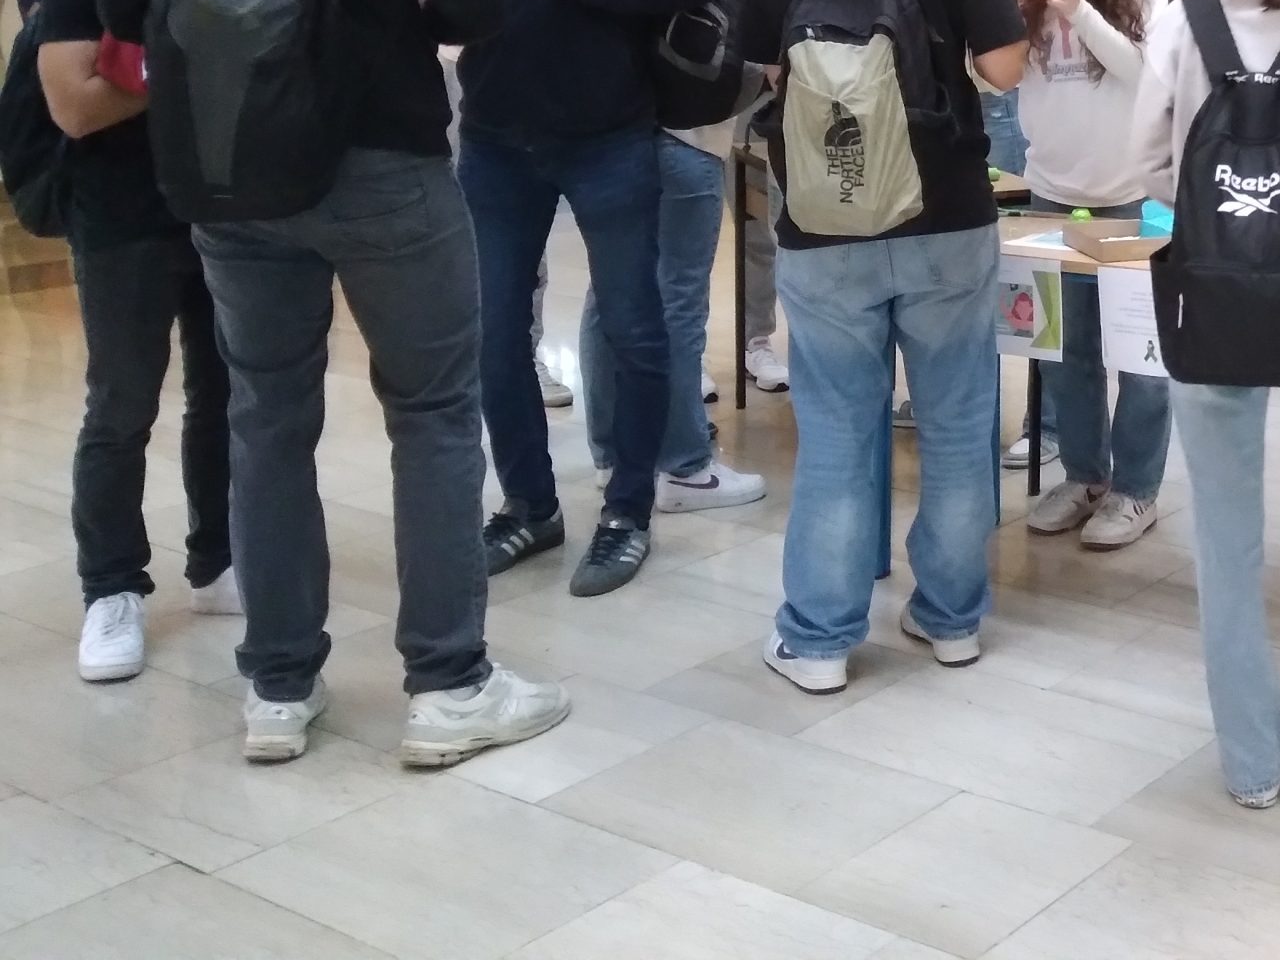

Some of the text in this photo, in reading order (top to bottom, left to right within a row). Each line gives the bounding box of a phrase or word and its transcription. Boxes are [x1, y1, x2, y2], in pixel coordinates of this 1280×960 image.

[826, 145, 840, 176] THE
[839, 148, 854, 203] NORTH
[851, 146, 865, 187] FACE
